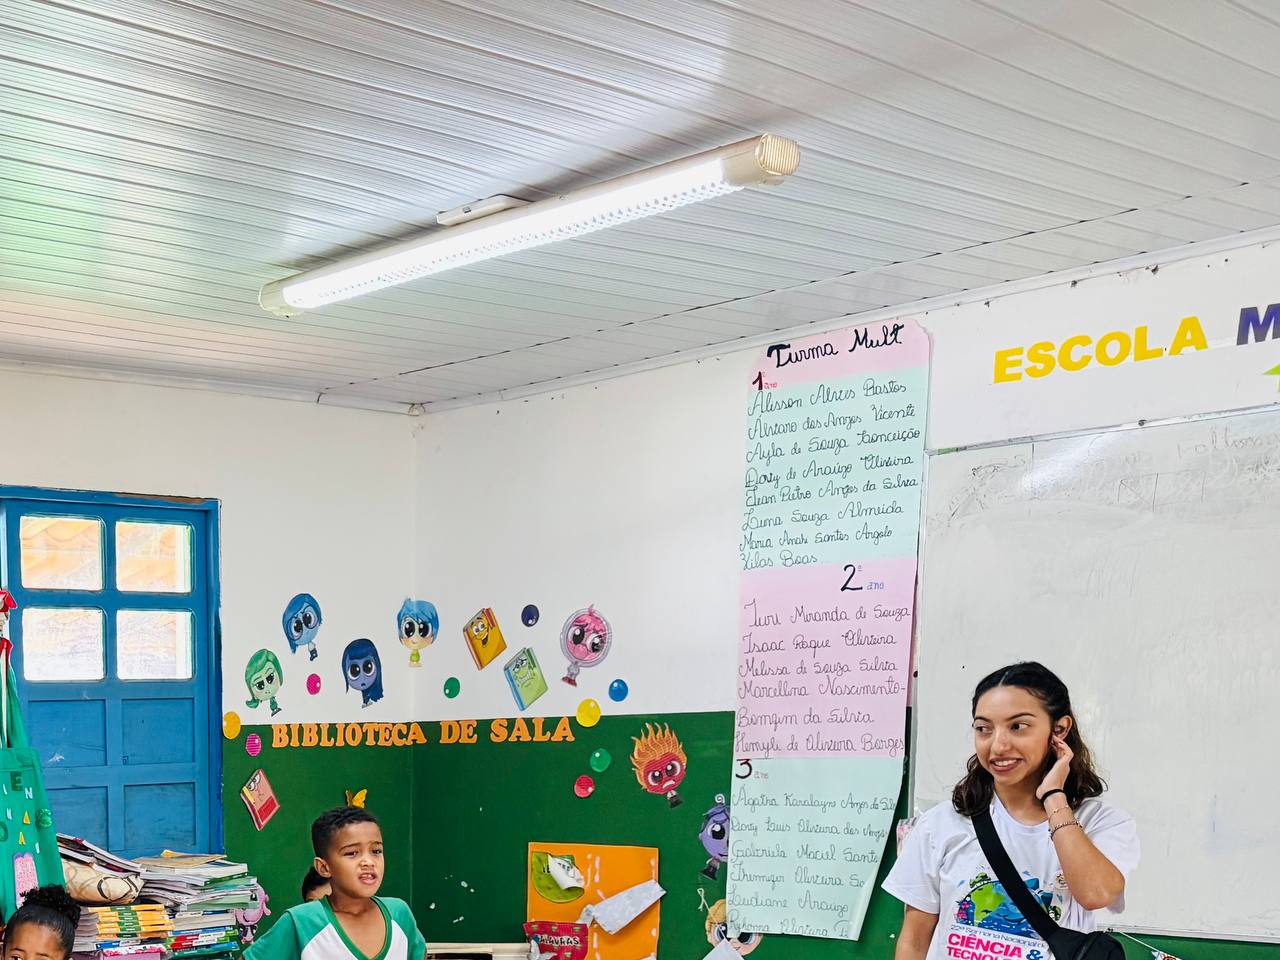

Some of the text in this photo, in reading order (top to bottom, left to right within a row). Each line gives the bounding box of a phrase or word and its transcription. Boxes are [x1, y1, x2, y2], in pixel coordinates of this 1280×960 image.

[766, 323, 905, 368] Turma Mult
[993, 316, 1208, 383] ESCOLA
[863, 378, 907, 397] Bastos
[870, 403, 916, 421] Vicente
[746, 442, 785, 466] Ayla
[808, 436, 849, 455] Souza
[883, 474, 919, 490] Silva
[791, 509, 830, 526] Souza
[838, 500, 905, 520] Almeida
[739, 531, 774, 552] Maria
[814, 529, 850, 544] Santos
[780, 549, 818, 567] Boas
[790, 605, 850, 624] Miranda
[873, 604, 911, 622] Souza
[738, 657, 791, 678] Melissa
[814, 661, 852, 677] Souza
[859, 656, 898, 672] Silva
[827, 707, 875, 724] Silva
[271, 717, 576, 749] BIBLIOTECA DE SALA
[948, 933, 1022, 957] CIÊNCIA
